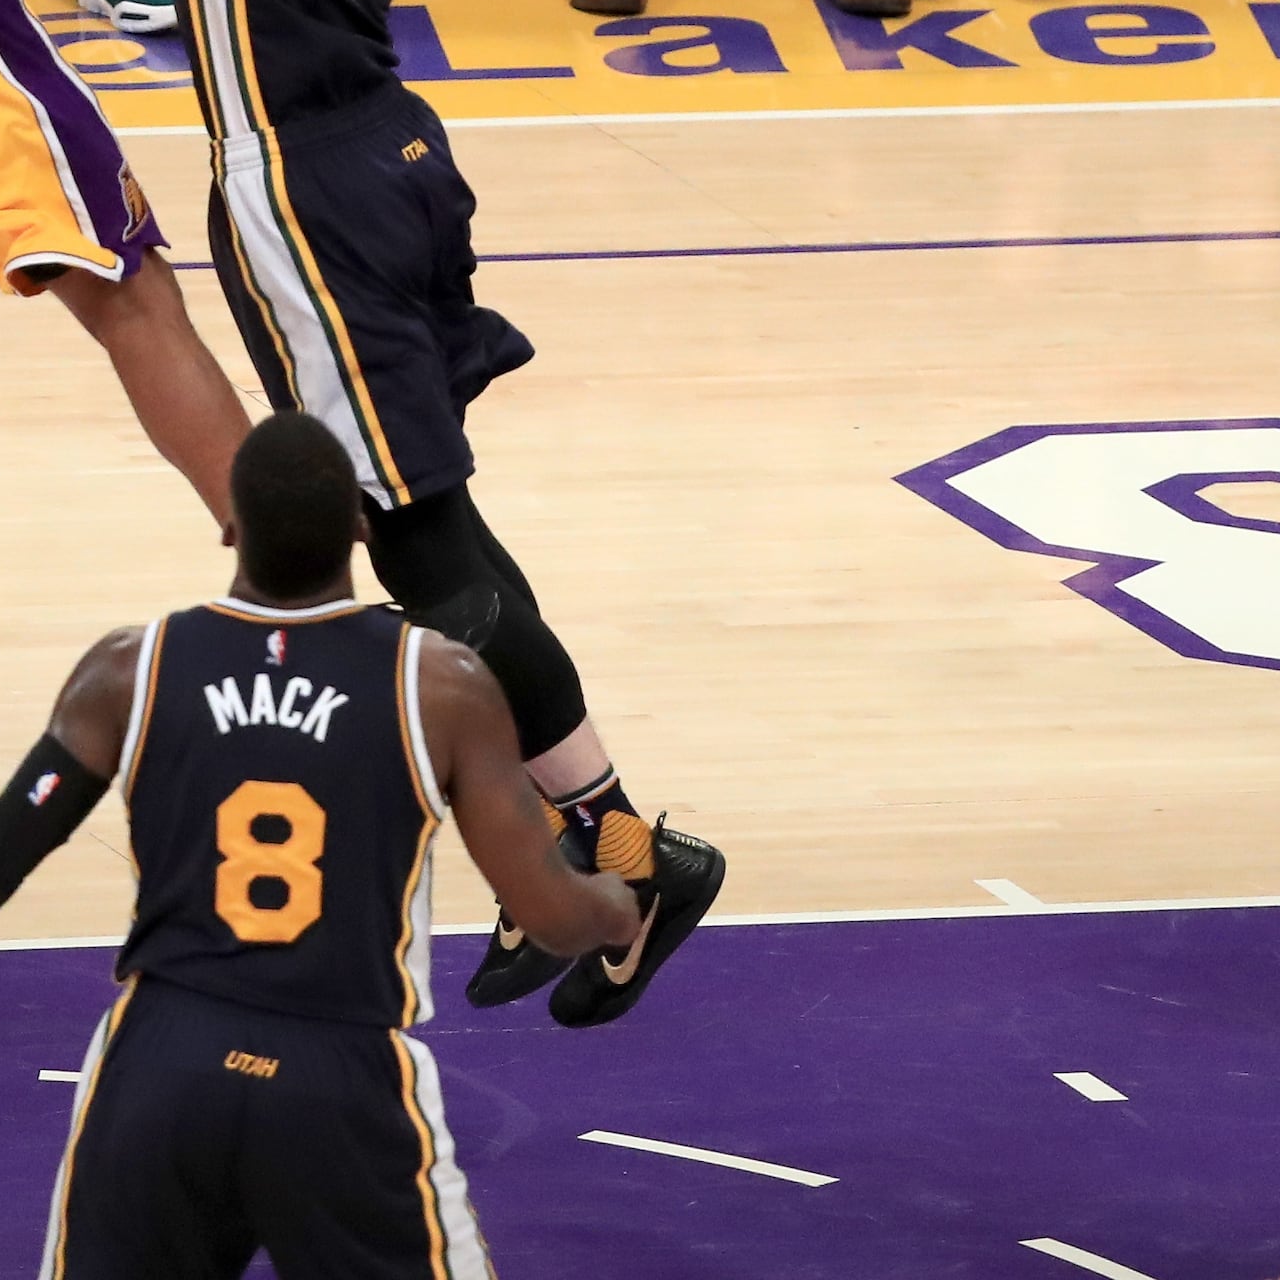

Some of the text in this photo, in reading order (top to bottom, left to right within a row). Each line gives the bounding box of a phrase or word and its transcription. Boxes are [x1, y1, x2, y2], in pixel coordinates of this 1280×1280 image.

[204, 673, 349, 742] MACK
[215, 779, 326, 944] 8
[224, 1050, 280, 1078] UTAH
